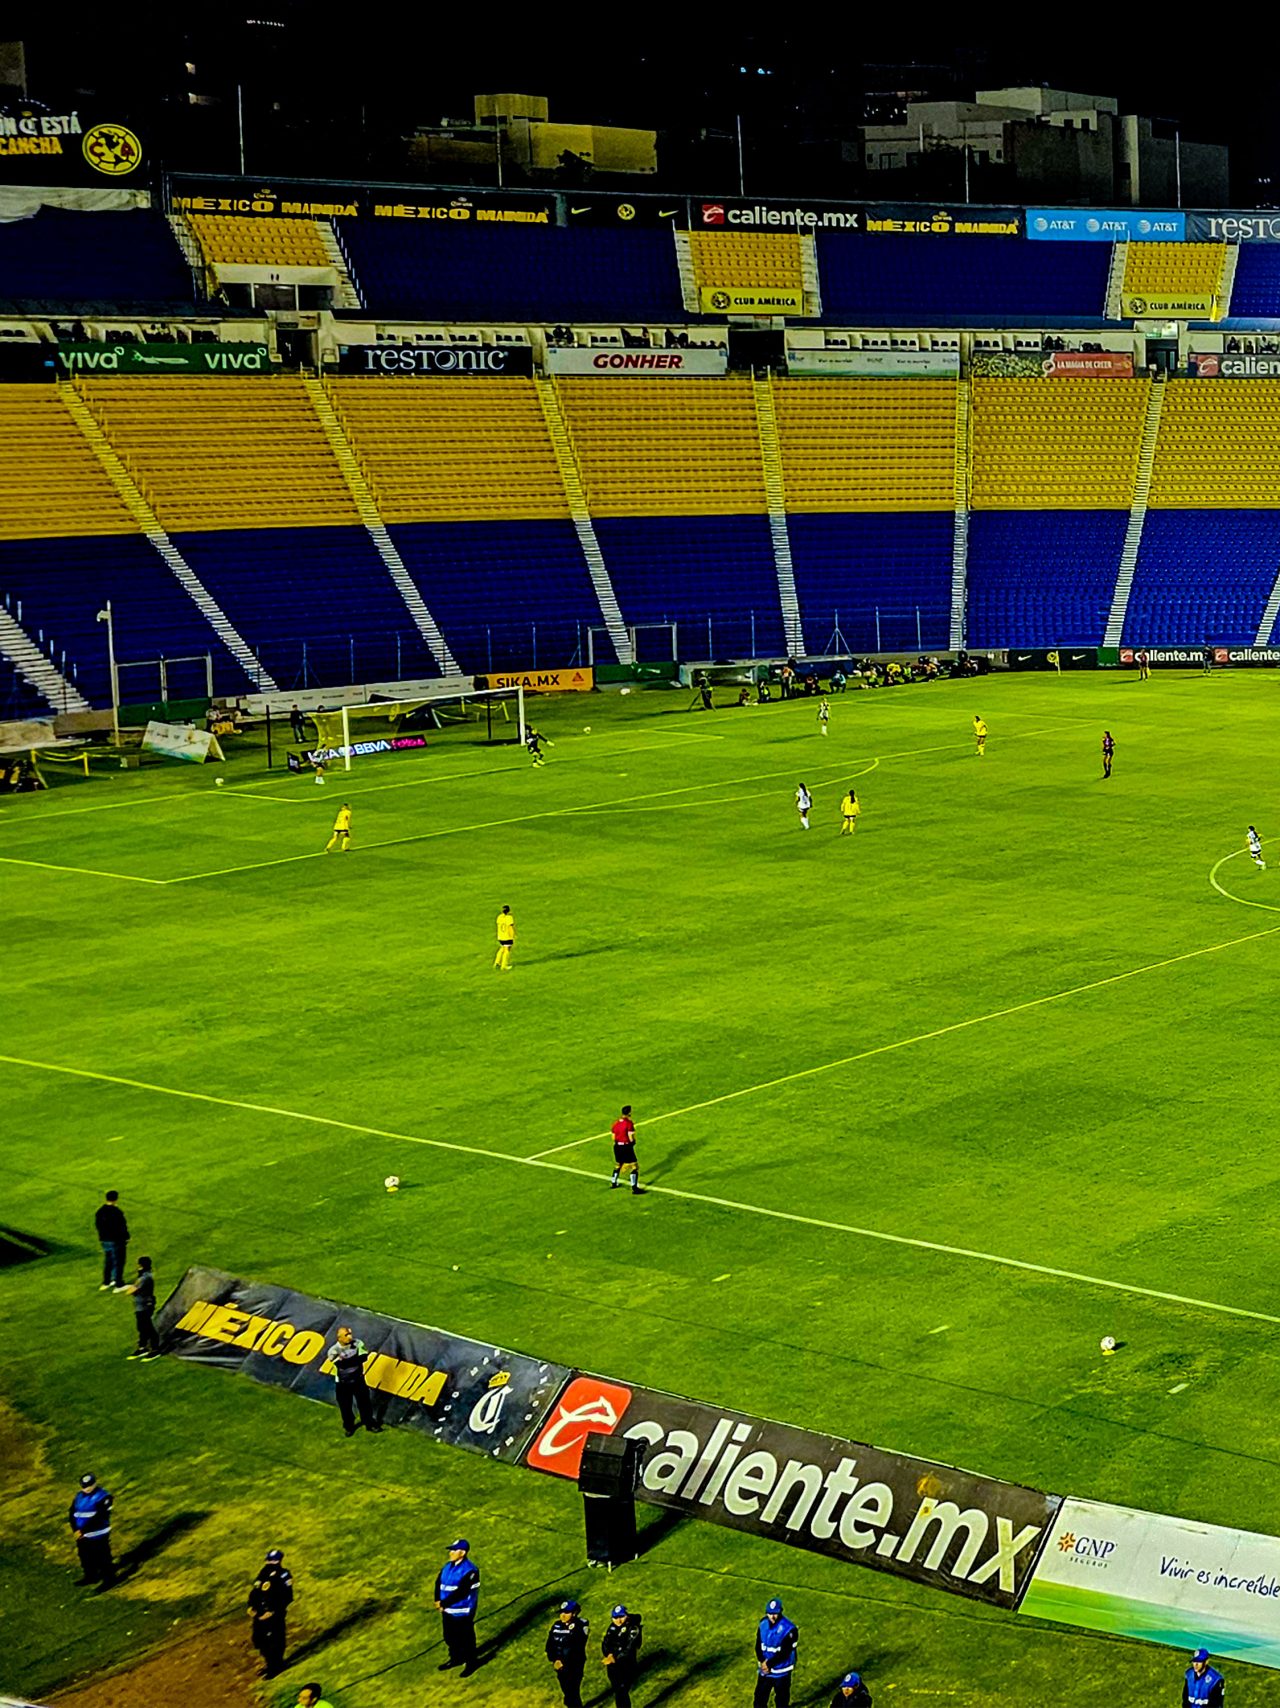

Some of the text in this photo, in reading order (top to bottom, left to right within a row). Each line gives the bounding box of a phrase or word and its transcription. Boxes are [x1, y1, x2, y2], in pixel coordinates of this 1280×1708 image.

[40, 111, 82, 135] ESTÁ
[172, 196, 274, 212] MÉXICO
[374, 204, 470, 219] MÉXICO
[728, 206, 859, 228] caliente.mx
[866, 219, 950, 233] MÉXICO
[1049, 220, 1077, 230] AT&T
[1101, 221, 1128, 231] AT&T
[1152, 222, 1179, 232] AT&T
[734, 296, 796, 307] CLUB AMÉRICA
[1149, 301, 1206, 311] CLUB AMÉRICA
[593, 354, 683, 369] GONHER
[496, 674, 560, 690] SIKA.MX
[354, 740, 392, 755] BBVA
[175, 1301, 326, 1365] MÉXICO
[1074, 1534, 1115, 1560] GNP
[1159, 1556, 1280, 1599] Vivir es increíble
